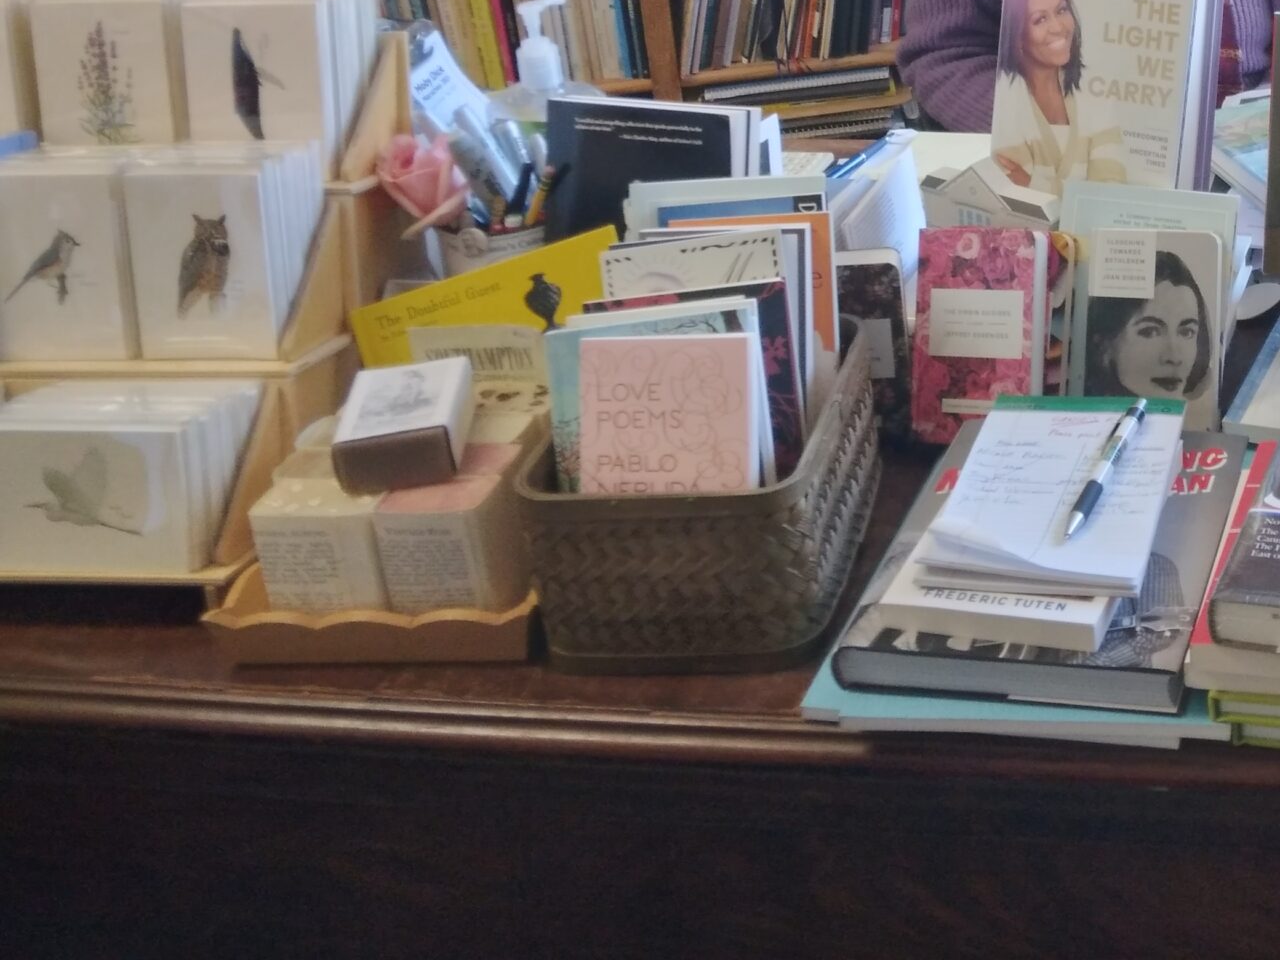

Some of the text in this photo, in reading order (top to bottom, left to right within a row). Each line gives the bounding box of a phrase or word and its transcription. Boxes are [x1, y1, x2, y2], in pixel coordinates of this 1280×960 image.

[1103, 22, 1179, 53] LIGHT
[1136, 54, 1175, 81] WE
[413, 65, 446, 94] Moby Dick
[1089, 76, 1173, 109] CARRY
[1122, 129, 1168, 144] OVERCOMING
[1129, 149, 1167, 160] UNCERTAIN
[1146, 158, 1166, 169] TIMES
[375, 314, 402, 330] The
[406, 291, 462, 321] Doubtful
[597, 383, 661, 402] LOVE
[597, 410, 682, 429] POEMS
[597, 454, 678, 473] PABLO
[1260, 527, 1277, 536] The
[1251, 549, 1271, 559] East
[1255, 542, 1273, 551] The
[923, 586, 1067, 612] FREDERIC TUTEN
